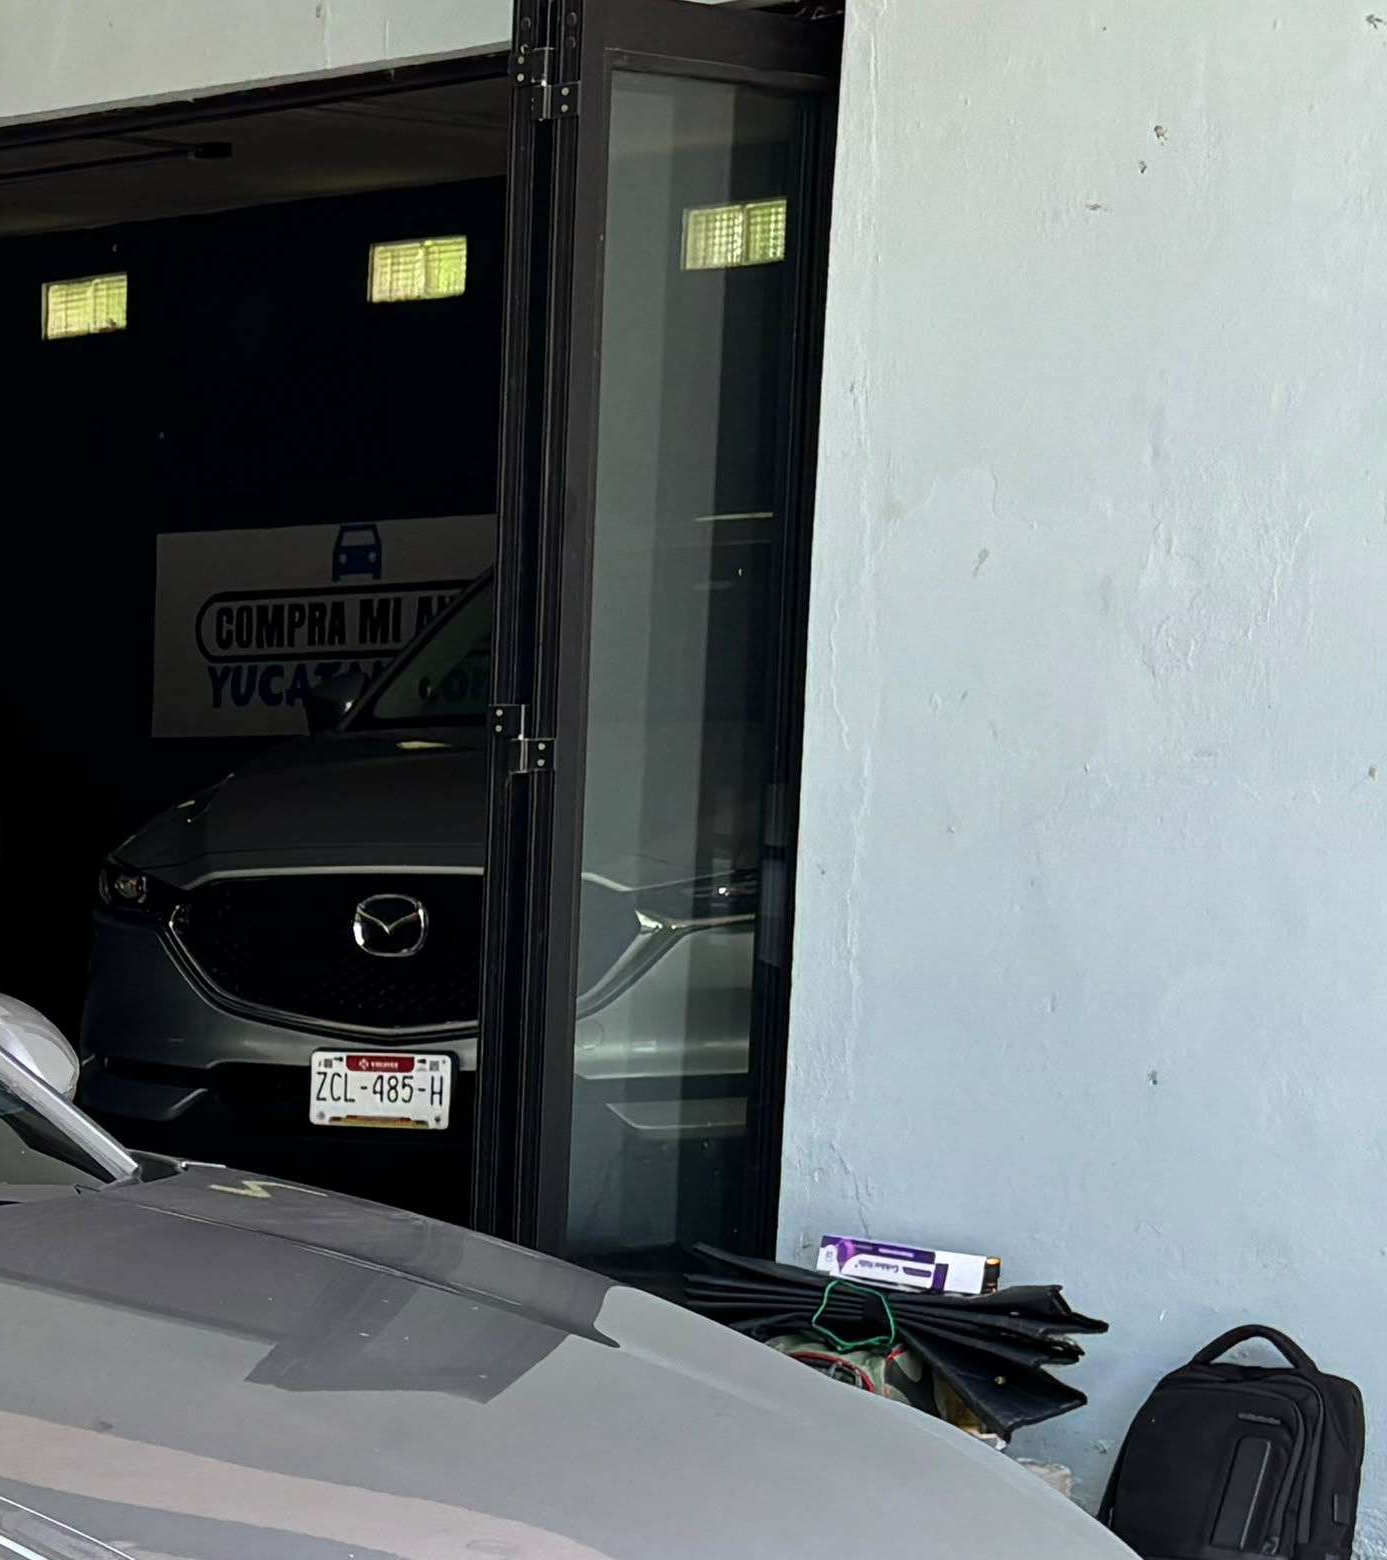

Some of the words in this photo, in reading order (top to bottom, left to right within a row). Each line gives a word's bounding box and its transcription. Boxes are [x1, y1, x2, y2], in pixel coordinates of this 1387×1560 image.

[215, 602, 346, 650] COMPRA
[358, 597, 402, 645] MI
[316, 1071, 444, 1107] ZCL-485-H
